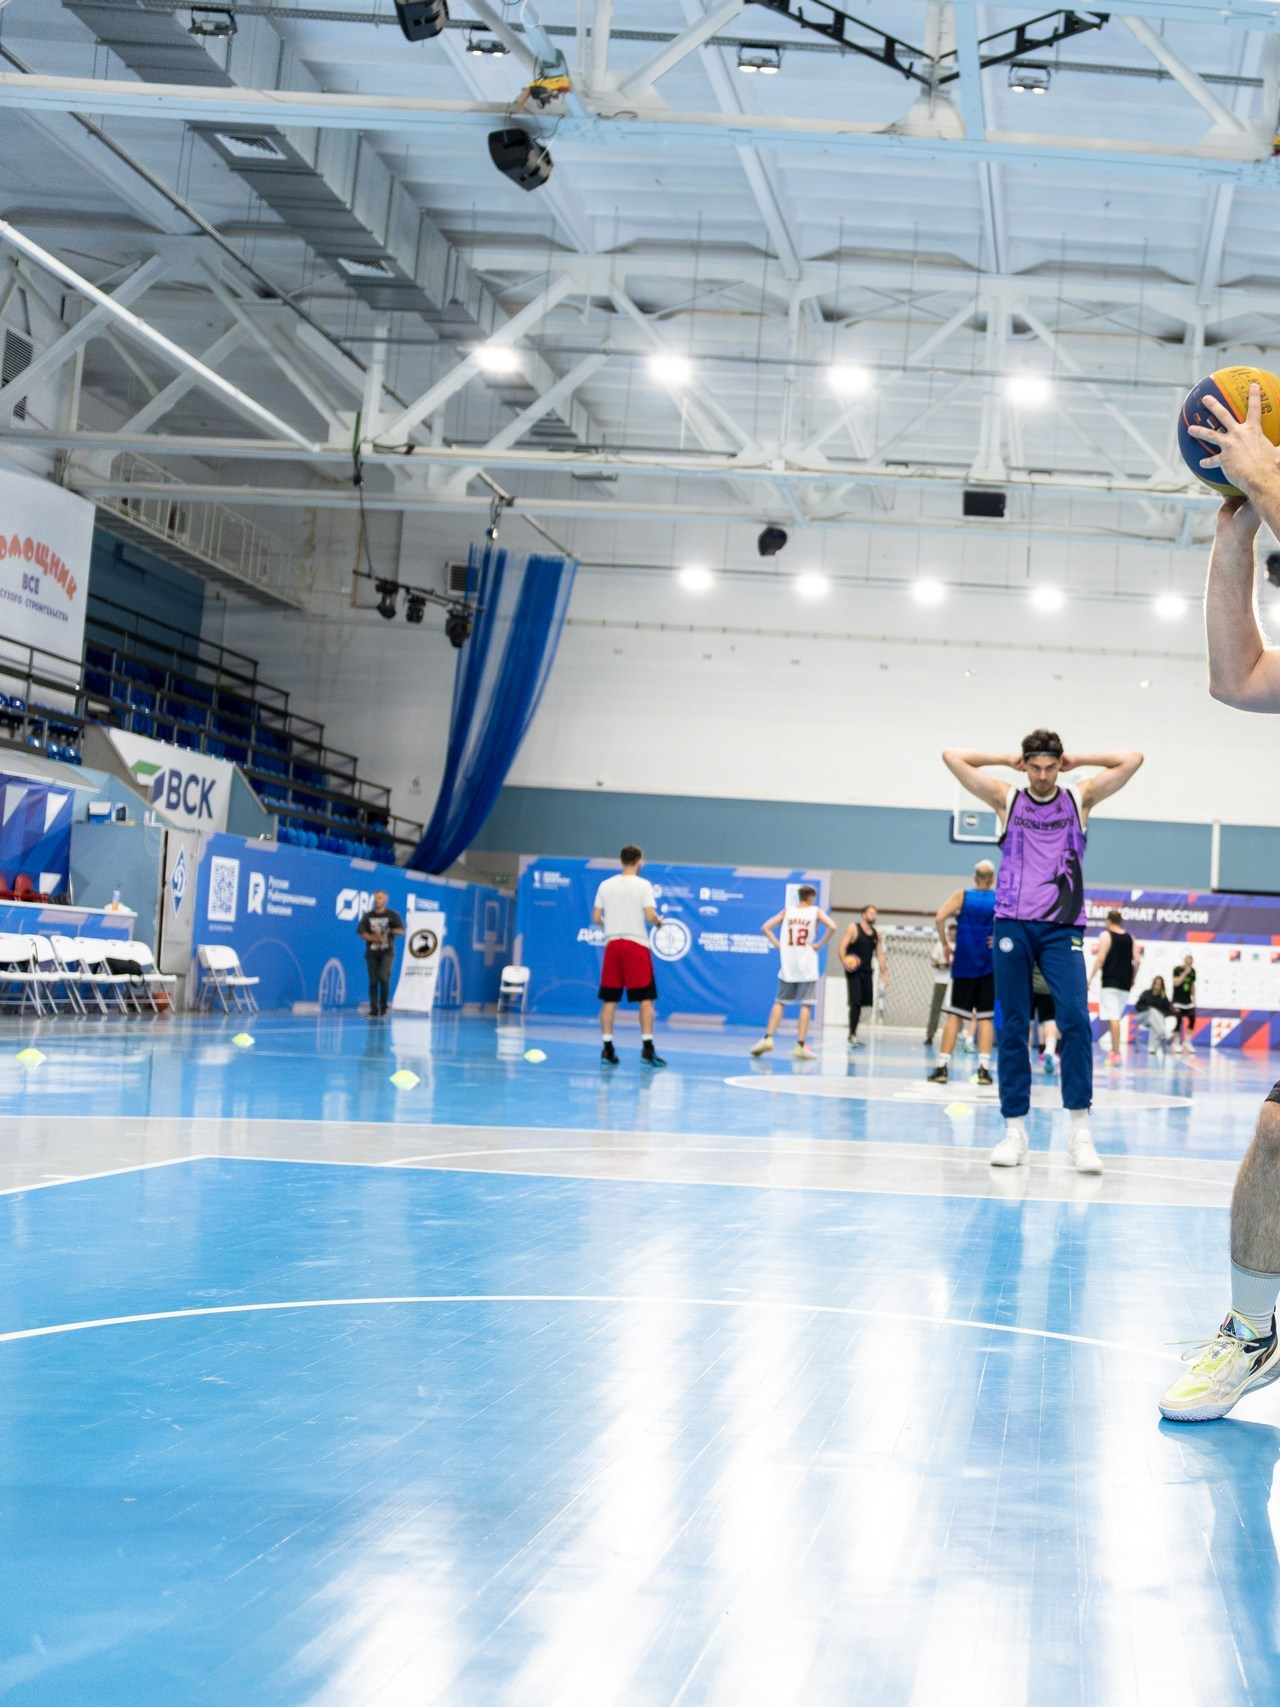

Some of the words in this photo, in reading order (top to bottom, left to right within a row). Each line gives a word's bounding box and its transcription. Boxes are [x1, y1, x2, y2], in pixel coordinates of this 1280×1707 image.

[22, 572, 40, 595] ВСЕ
[165, 768, 216, 819] ВСК
[1156, 908, 1209, 924] РОССИИ
[788, 928, 809, 946] 12
